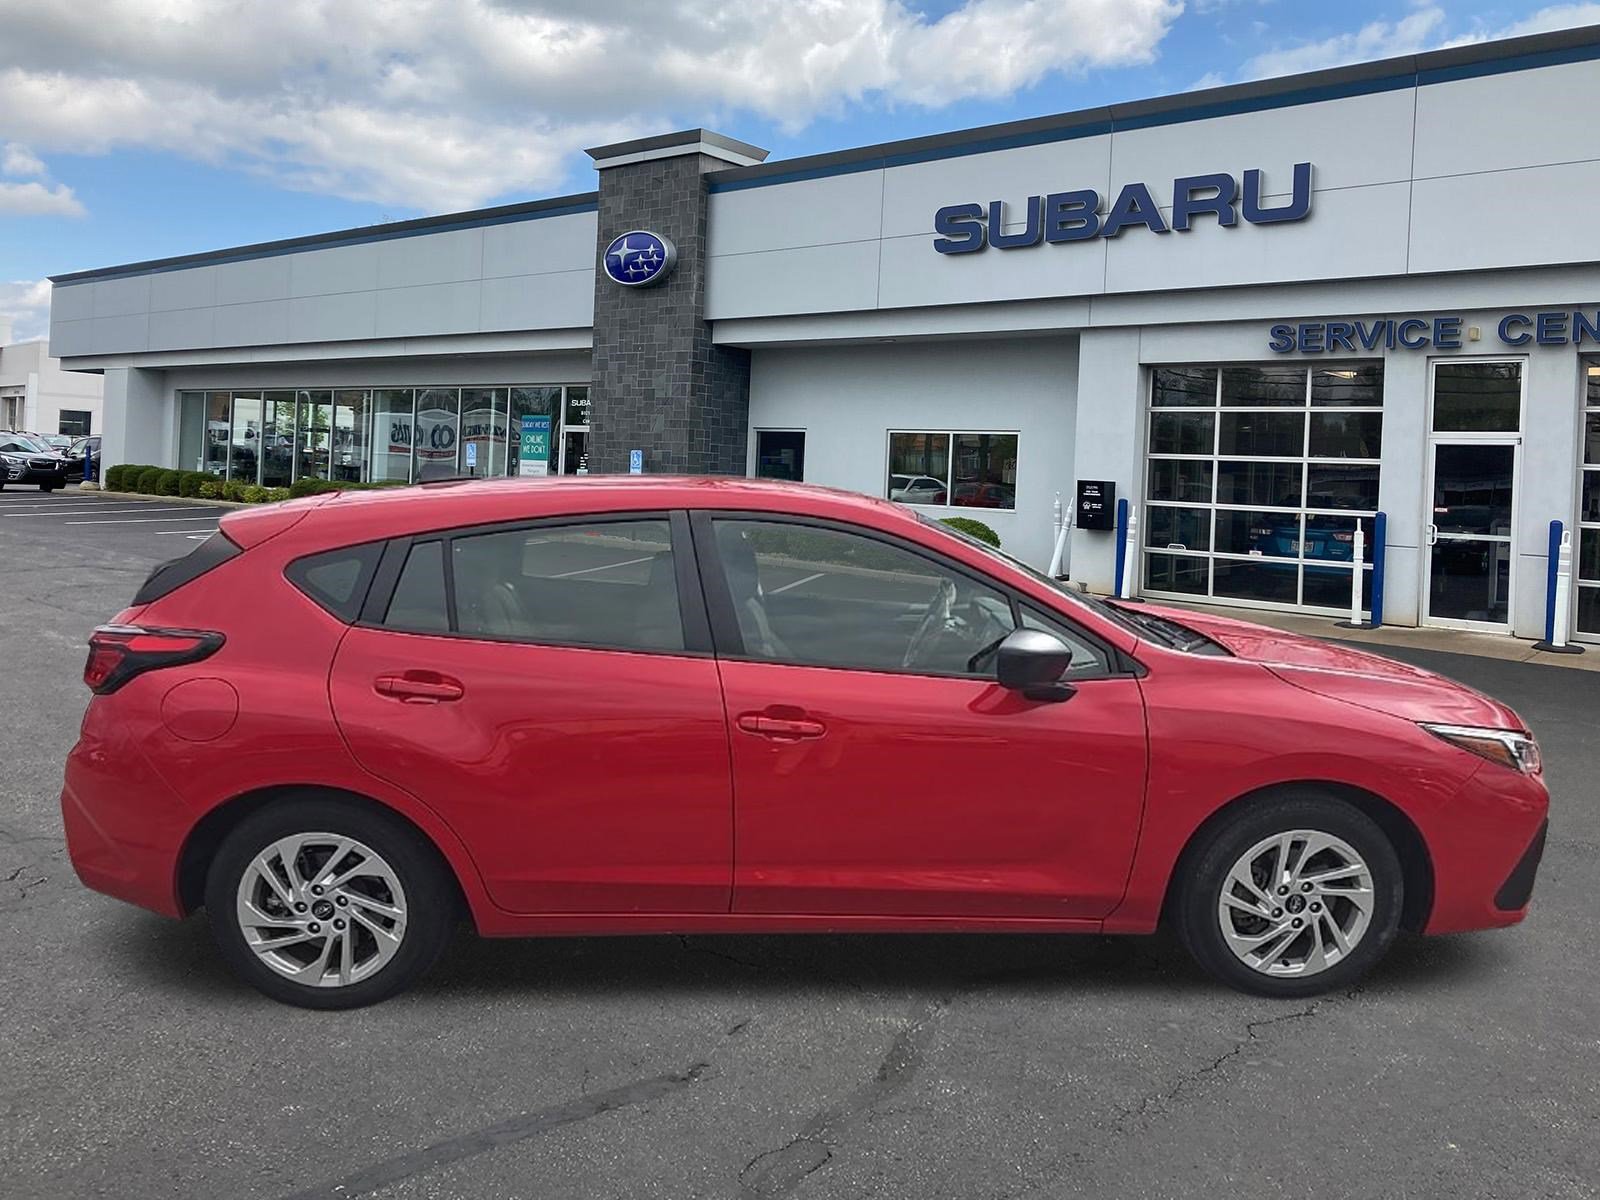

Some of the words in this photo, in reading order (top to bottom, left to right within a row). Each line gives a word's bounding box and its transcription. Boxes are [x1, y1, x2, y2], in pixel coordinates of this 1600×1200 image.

[933, 161, 1313, 255] SUBARU
[1269, 317, 1463, 353] SERVICE
[1497, 310, 1600, 346] CEN
[571, 399, 592, 407] SUBA
